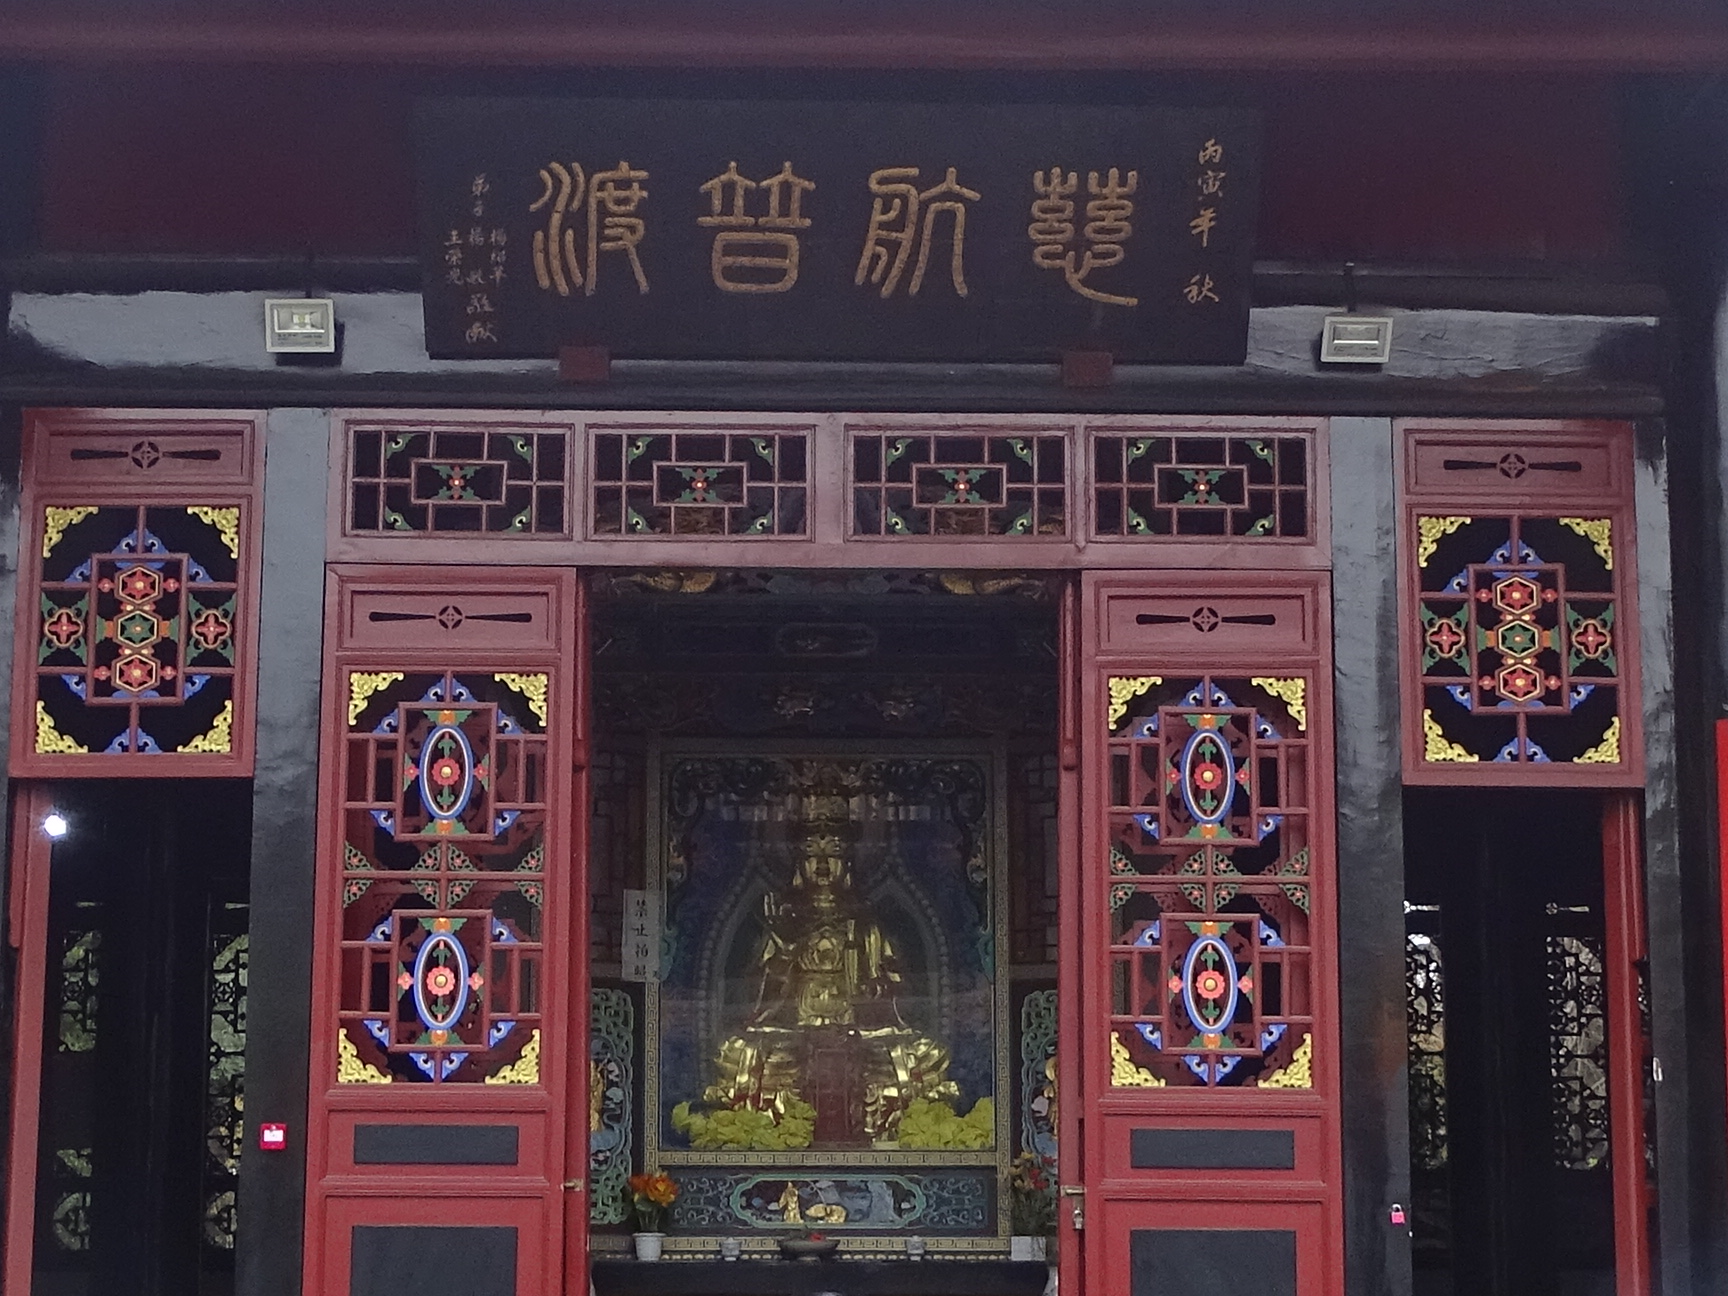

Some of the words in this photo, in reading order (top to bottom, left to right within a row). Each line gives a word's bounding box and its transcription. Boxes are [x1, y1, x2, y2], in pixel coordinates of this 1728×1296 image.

[529, 159, 1141, 309] 慈航普渡
[1183, 137, 1227, 304] 丙寅年秋
